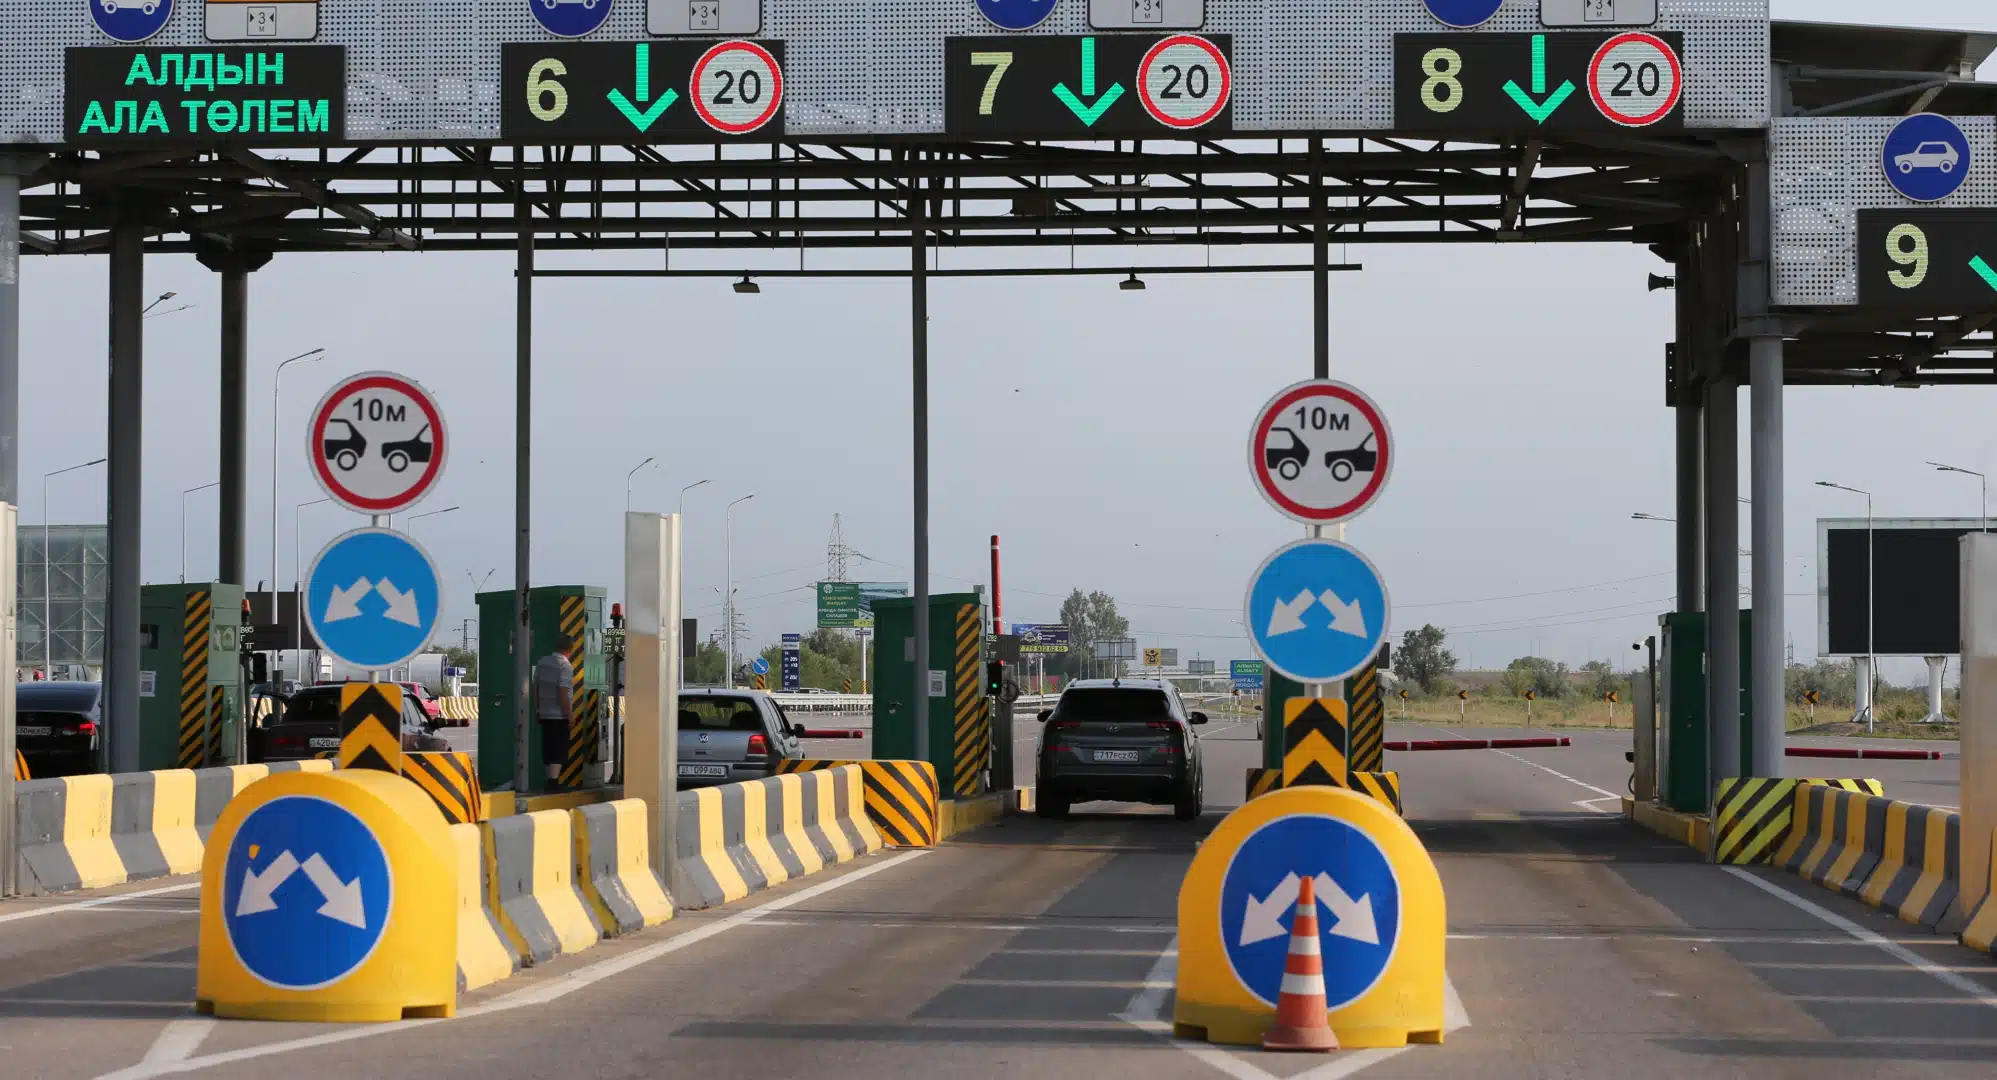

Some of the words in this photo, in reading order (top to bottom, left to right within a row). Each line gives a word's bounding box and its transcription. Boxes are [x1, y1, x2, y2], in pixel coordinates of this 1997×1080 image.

[258, 12, 266, 24] 3
[700, 6, 708, 18] 3
[1143, 0, 1151, 11] 3
[125, 52, 284, 92] АЛДЫН
[526, 58, 569, 121] 6
[712, 69, 761, 105] 20
[970, 51, 1013, 115] 7
[1159, 63, 1209, 99] 20
[1420, 47, 1463, 112] 8
[1610, 61, 1661, 97] 20
[78, 100, 170, 134] АЛА
[180, 99, 329, 133] ТӨЛЕМ
[1885, 222, 1929, 289] 9
